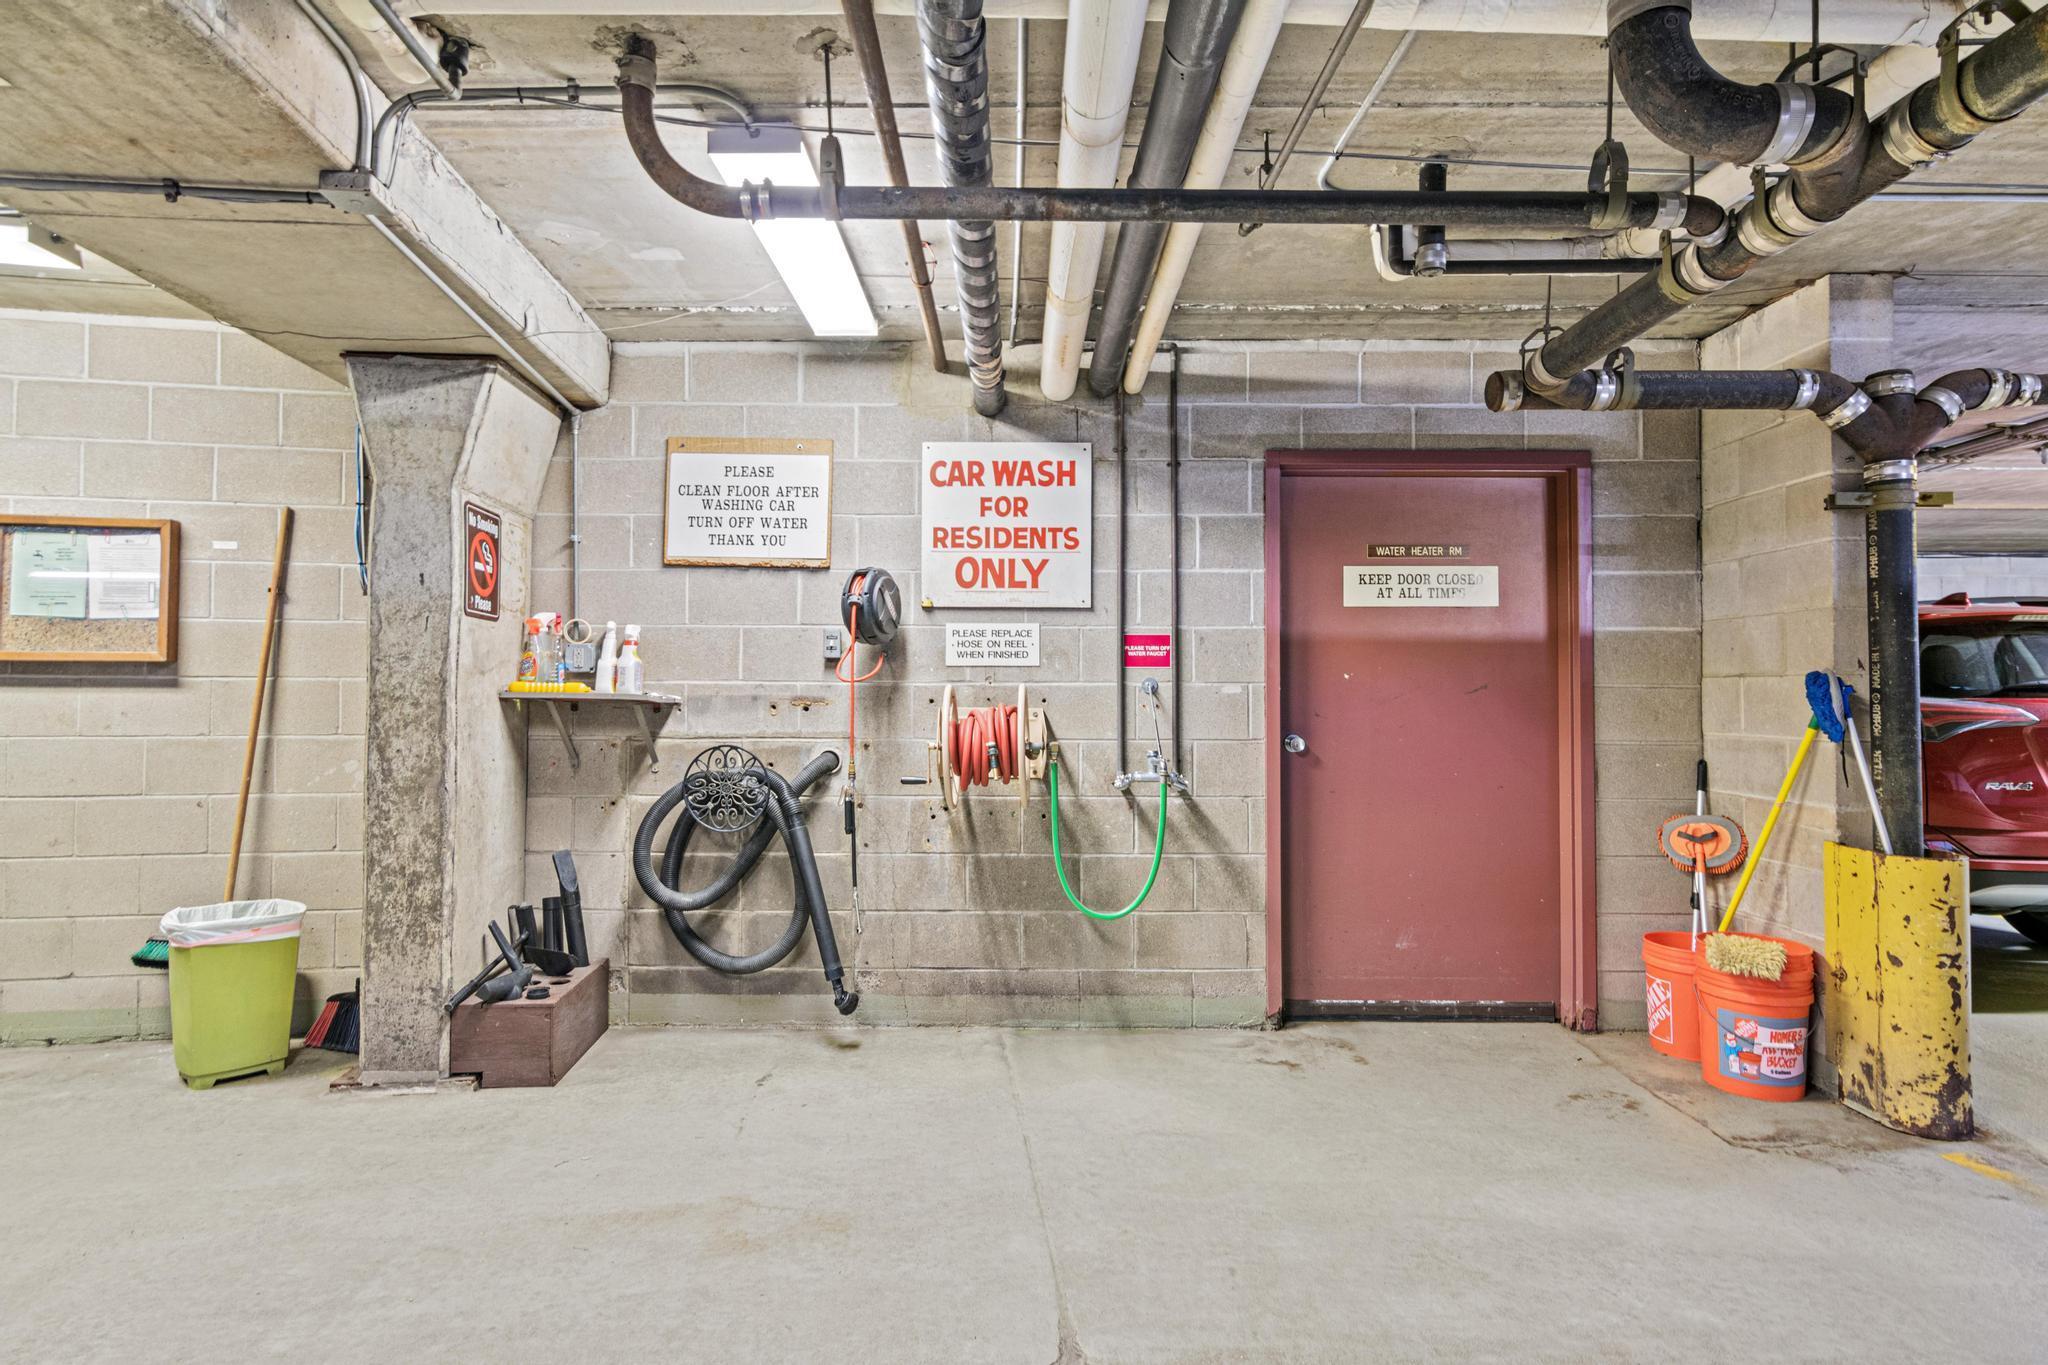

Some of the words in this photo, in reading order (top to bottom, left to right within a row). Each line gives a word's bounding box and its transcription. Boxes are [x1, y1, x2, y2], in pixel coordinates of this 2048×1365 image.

[724, 465, 775, 478] PLEASE
[929, 459, 985, 488] CAR
[992, 459, 1077, 488] WASH
[678, 484, 721, 497] CLEAN
[727, 485, 770, 498] FLOOR
[776, 486, 820, 498] AFTER
[702, 498, 763, 511] WASHING
[769, 499, 796, 512] CAR
[979, 495, 1029, 518] FOR
[468, 511, 476, 527] No
[477, 514, 498, 539] Smoking
[688, 516, 723, 528] TURN
[728, 516, 755, 529] OFF
[760, 517, 808, 530] WATER
[708, 534, 755, 546] THANK
[761, 534, 787, 547] YOU
[932, 525, 1080, 551] RESIDENTS
[1375, 546, 1406, 556] WATER
[1411, 546, 1444, 556] HEATER
[1449, 546, 1462, 556] RM
[954, 556, 1050, 589] ONLY
[1358, 573, 1392, 586] KEEP
[1397, 573, 1431, 586] DOOR
[1376, 587, 1394, 599] AT
[1398, 587, 1423, 599] ALL
[474, 594, 492, 612] Please
[952, 629, 988, 638] PLEASE
[991, 629, 1033, 638] REPLACE
[957, 639, 983, 649] HOSE
[986, 639, 1001, 649] ON
[1004, 639, 1028, 649] REEL
[956, 650, 984, 659] WHEN
[987, 650, 1029, 659] FINISHED
[1984, 781, 2034, 791] RAV4
[1766, 1055, 1798, 1069] BUCKET
